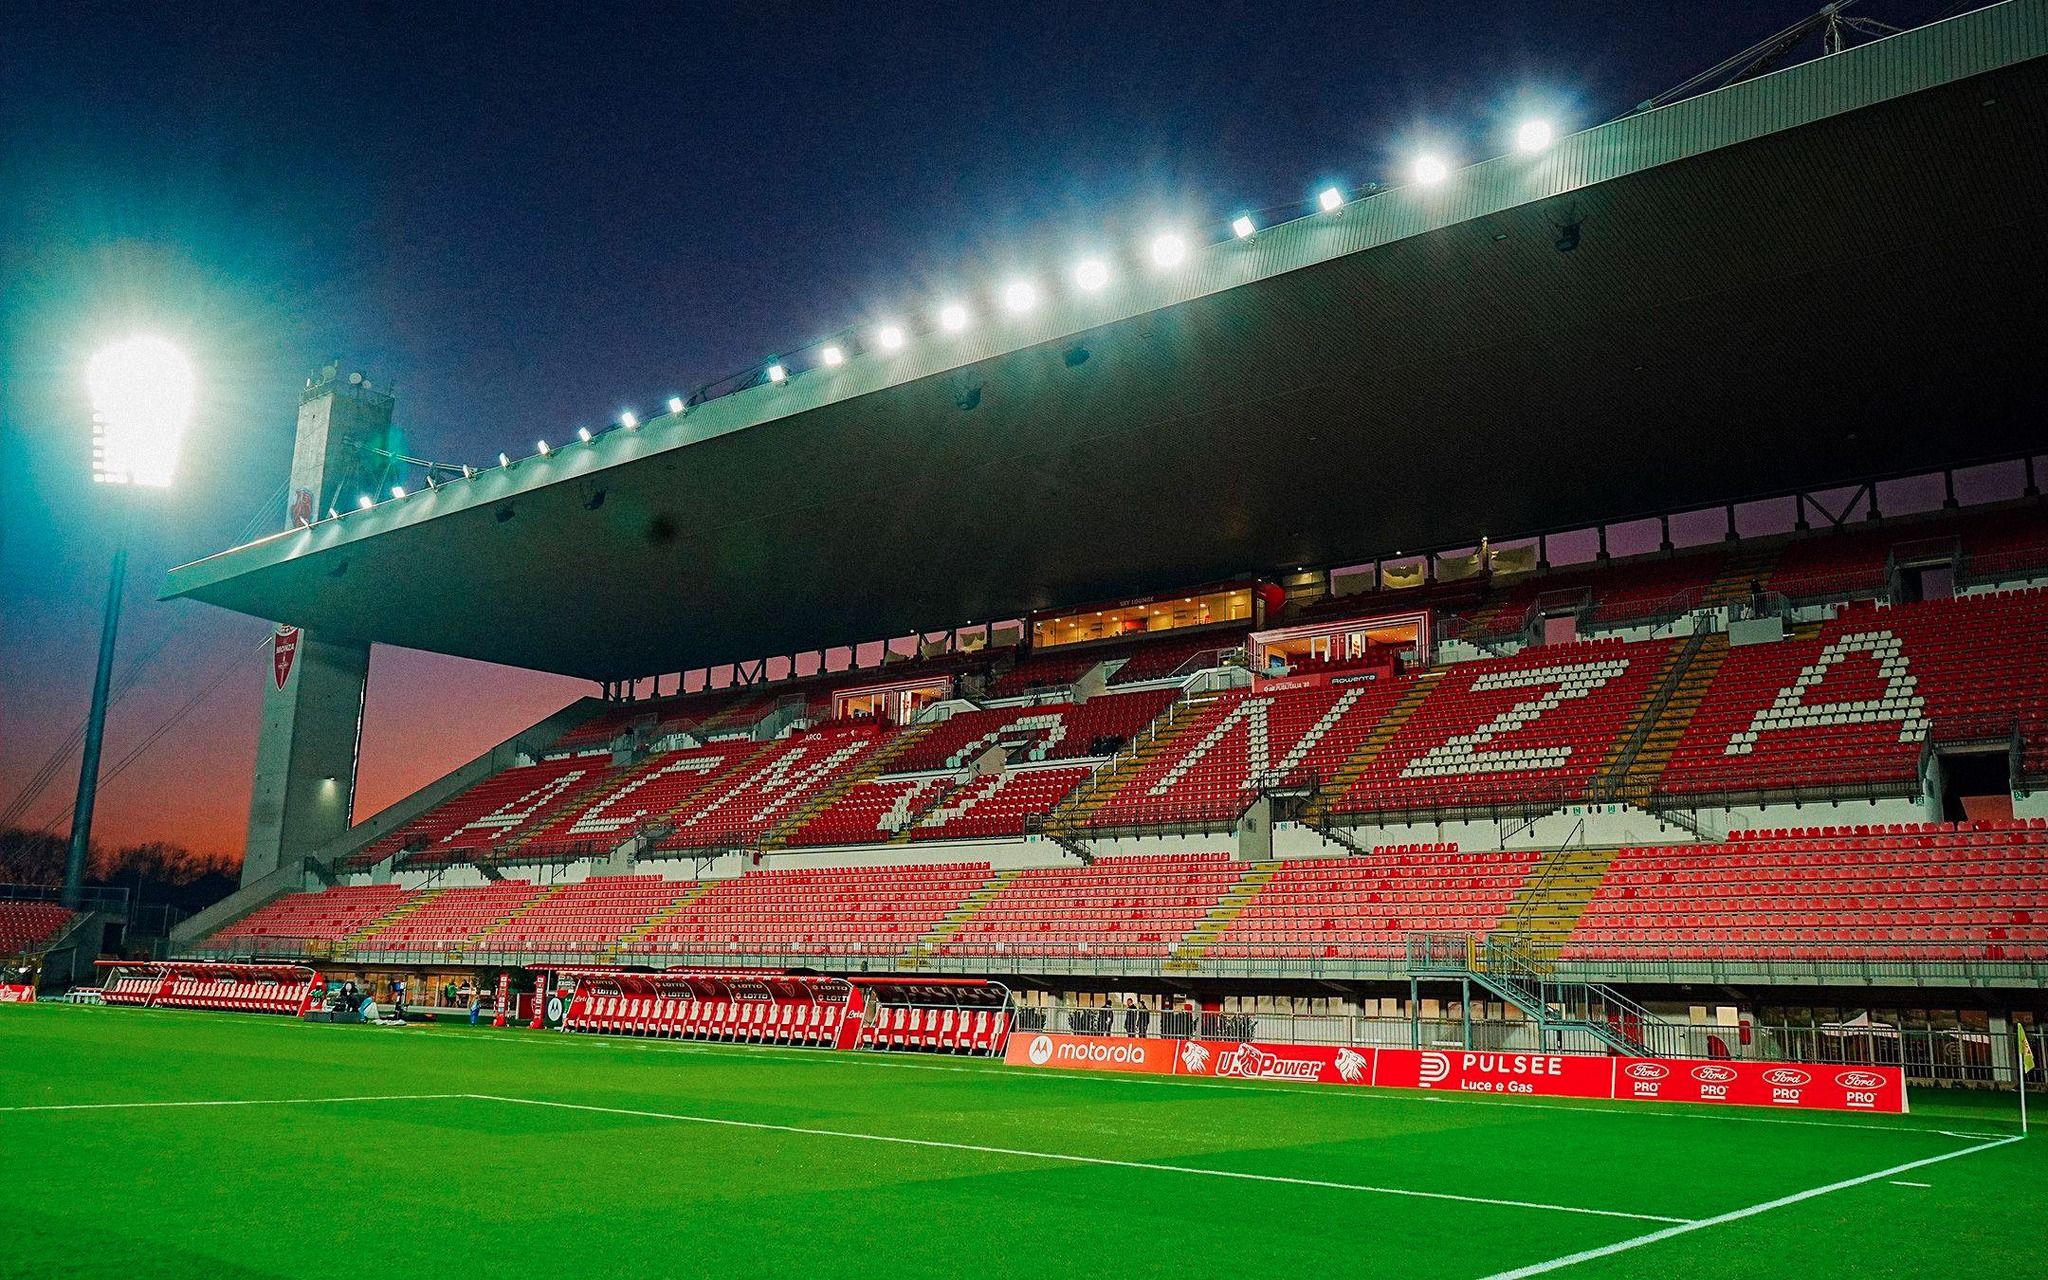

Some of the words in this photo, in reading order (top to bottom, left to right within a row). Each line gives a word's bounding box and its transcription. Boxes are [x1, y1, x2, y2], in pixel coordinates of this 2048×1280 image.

[805, 732, 822, 740] ARCO
[1057, 1042, 1145, 1063] motorola
[1463, 1054, 1562, 1075] PULSEE
[1633, 1064, 1661, 1077] Ford
[1700, 1067, 1728, 1080] Ford
[1771, 1071, 1801, 1084] Ford
[1844, 1073, 1876, 1087] Ford
[1461, 1079, 1492, 1091] Luce
[1496, 1083, 1504, 1091] e
[1508, 1081, 1534, 1093] Gas
